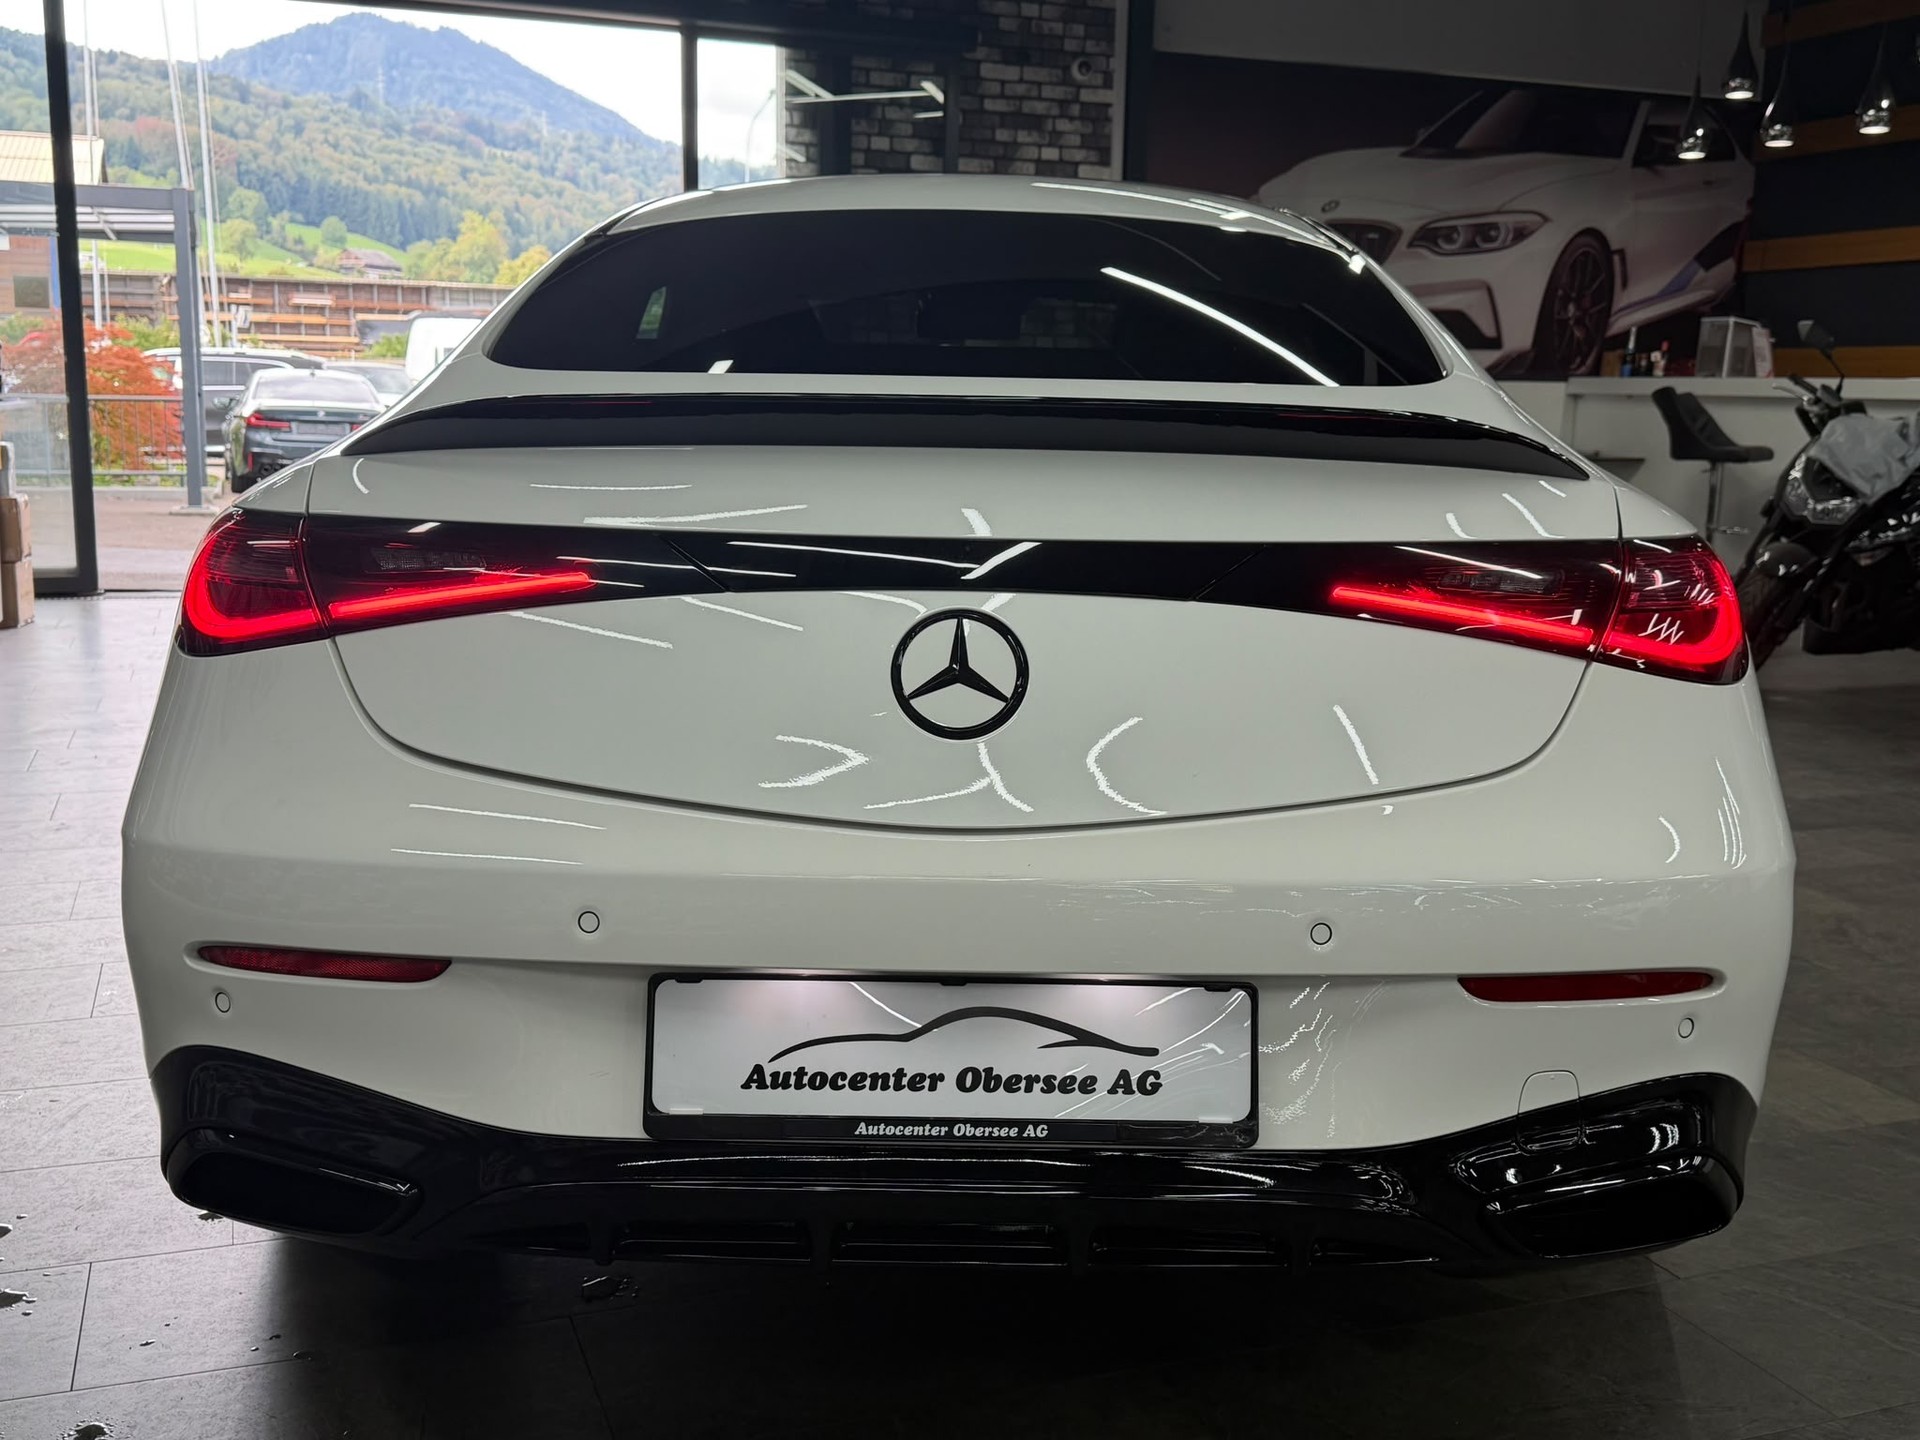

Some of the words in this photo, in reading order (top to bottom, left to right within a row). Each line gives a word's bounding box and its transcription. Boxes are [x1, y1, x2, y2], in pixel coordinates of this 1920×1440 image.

[740, 1063, 946, 1093] Autocenter
[955, 1066, 1098, 1095] Obersee
[1106, 1068, 1163, 1097] AG
[854, 1121, 949, 1136] Autocenter
[953, 1123, 1019, 1138] Obersee
[1022, 1124, 1049, 1138] AG
